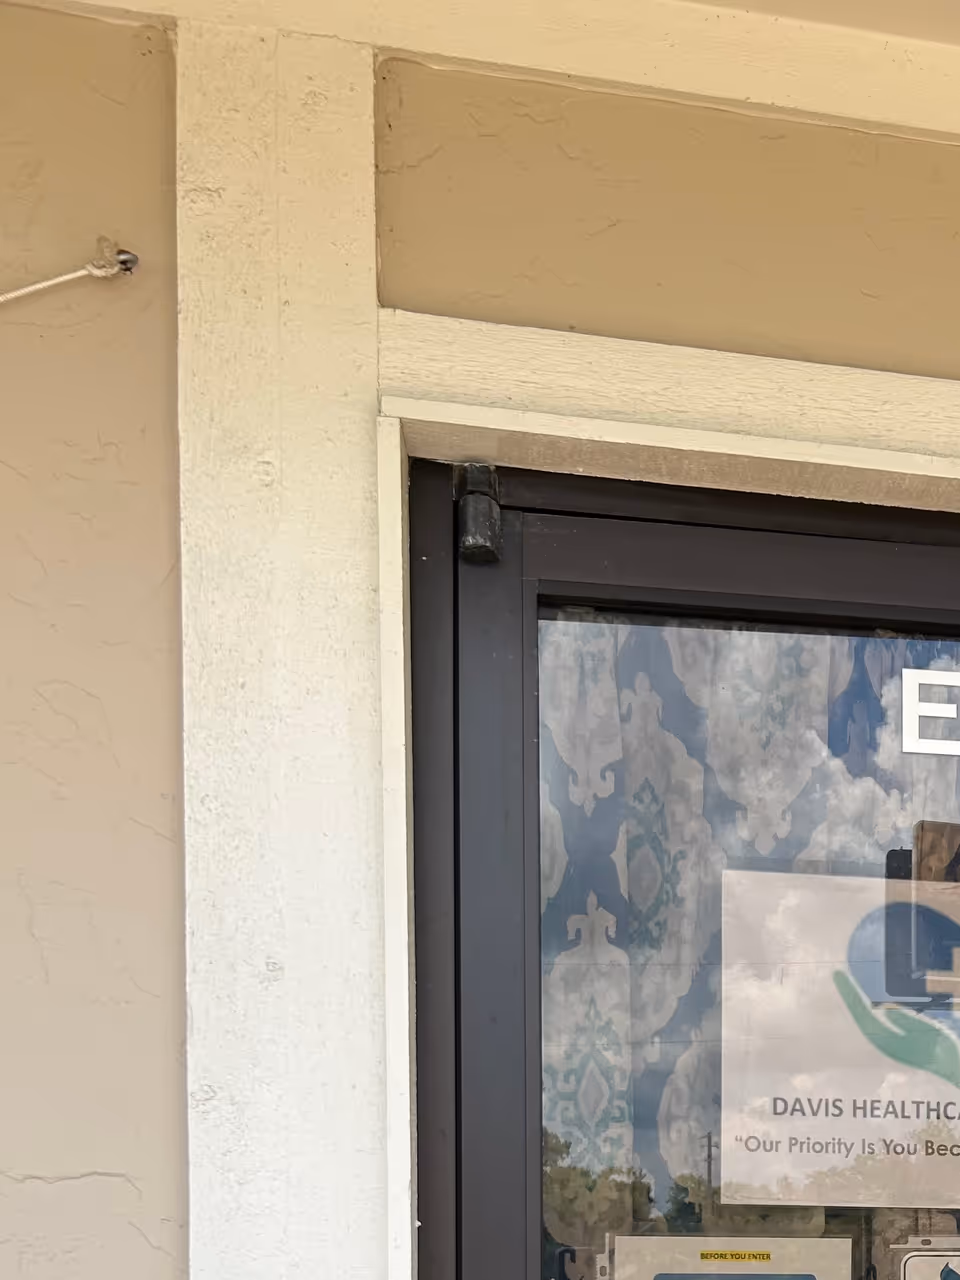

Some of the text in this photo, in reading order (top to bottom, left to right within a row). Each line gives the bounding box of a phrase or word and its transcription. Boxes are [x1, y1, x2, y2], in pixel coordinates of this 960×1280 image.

[772, 1097, 844, 1118] DAVIS
[735, 1135, 782, 1153] “Our
[788, 1137, 855, 1158] Priority
[861, 1139, 876, 1155] Is
[881, 1139, 918, 1156] You
[700, 1252, 771, 1261] BEFORE YOU ENTER
